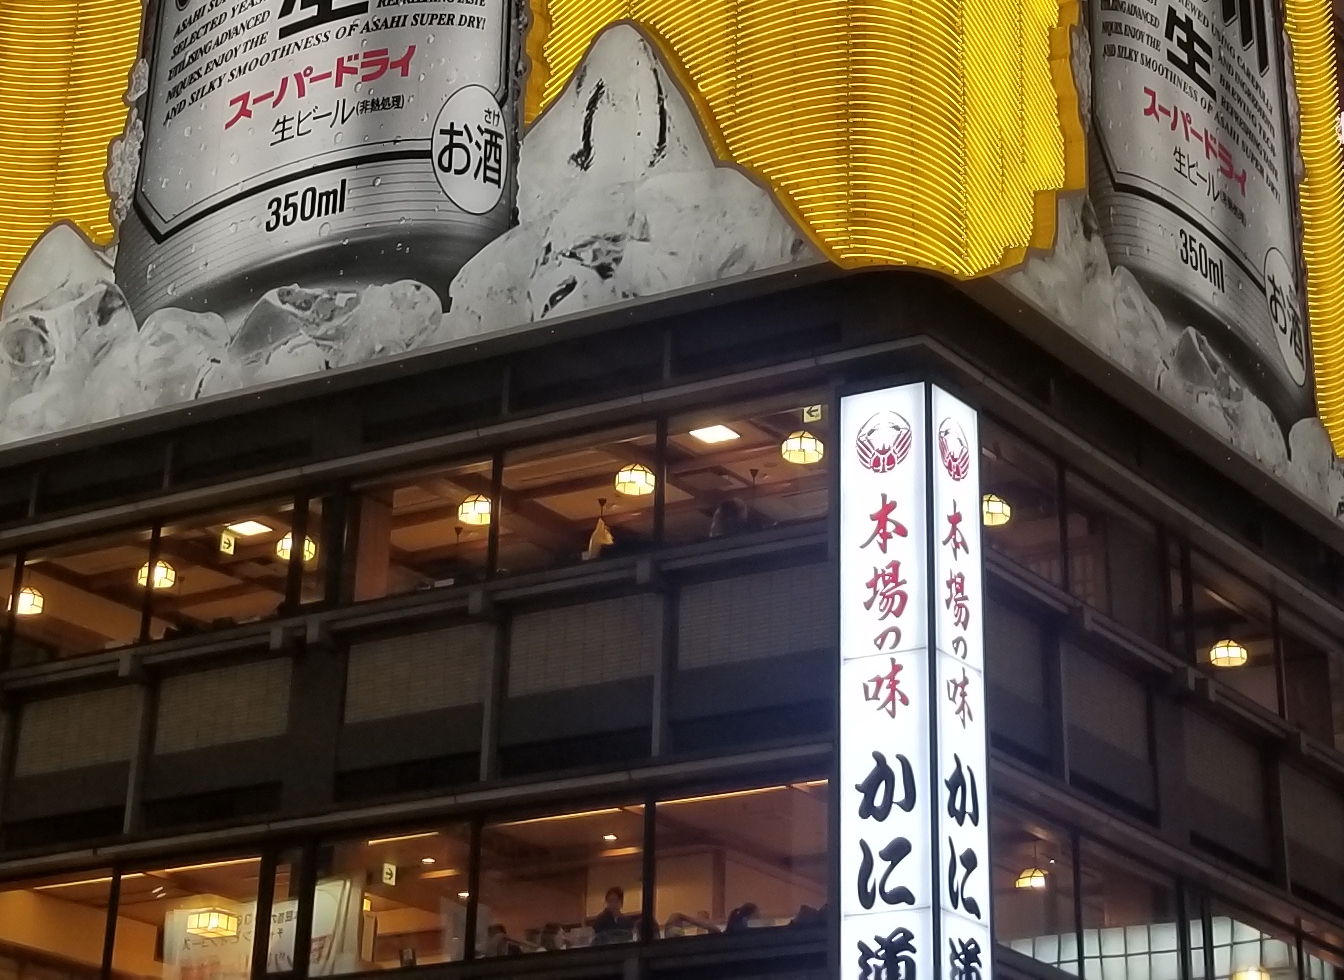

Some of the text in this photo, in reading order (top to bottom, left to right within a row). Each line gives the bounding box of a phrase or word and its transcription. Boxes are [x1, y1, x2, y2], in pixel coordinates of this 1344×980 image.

[171, 11, 227, 61] SELECTED
[173, 4, 207, 39] ASAHI
[205, 43, 243, 74] ENJOY
[242, 31, 270, 58] THE
[208, 10, 271, 51] ADVANCED
[1164, 4, 1217, 102] 生
[163, 13, 487, 126] AND SILKY SMOOTHNESS OF ASAHI SUPER DRY!
[225, 45, 416, 130] スーパードライ
[437, 122, 505, 189] お酒
[1142, 86, 1248, 199] スーパードライ
[265, 178, 347, 232] 350ml
[1179, 228, 1226, 294] 350ml
[859, 493, 910, 719] 本場の味
[941, 498, 974, 730] 本場の味
